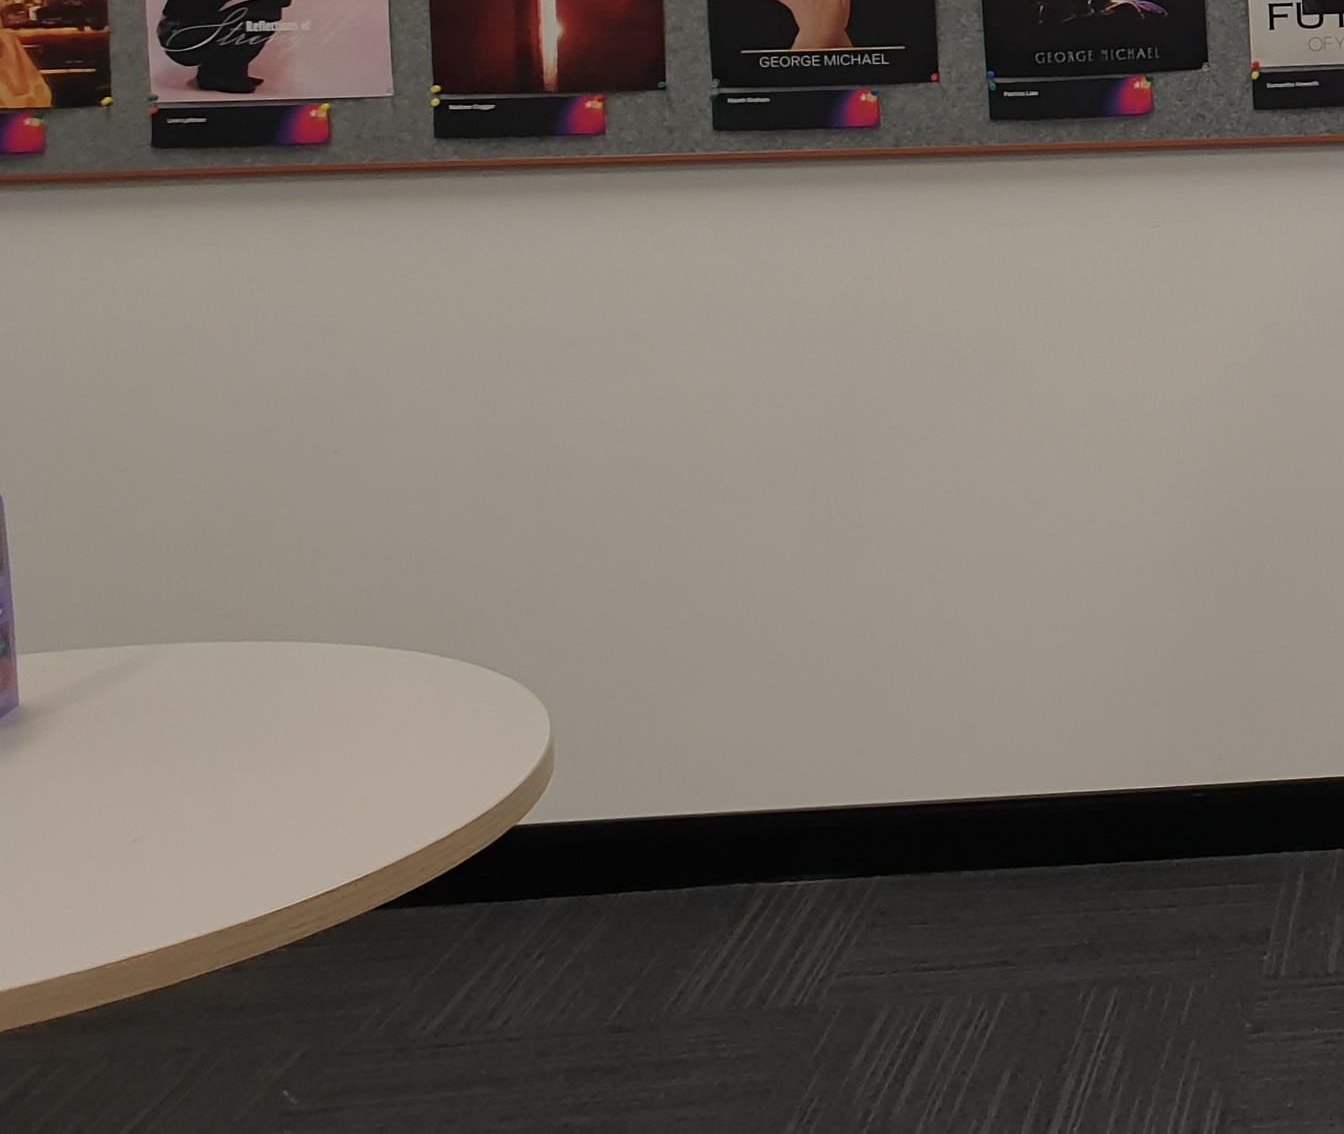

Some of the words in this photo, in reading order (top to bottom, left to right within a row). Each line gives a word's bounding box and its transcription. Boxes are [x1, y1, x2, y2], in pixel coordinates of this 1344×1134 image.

[1308, 36, 1333, 52] OF
[759, 55, 821, 68] GEORGE
[824, 53, 889, 67] MICHAEL
[1034, 50, 1094, 64] GEORGE
